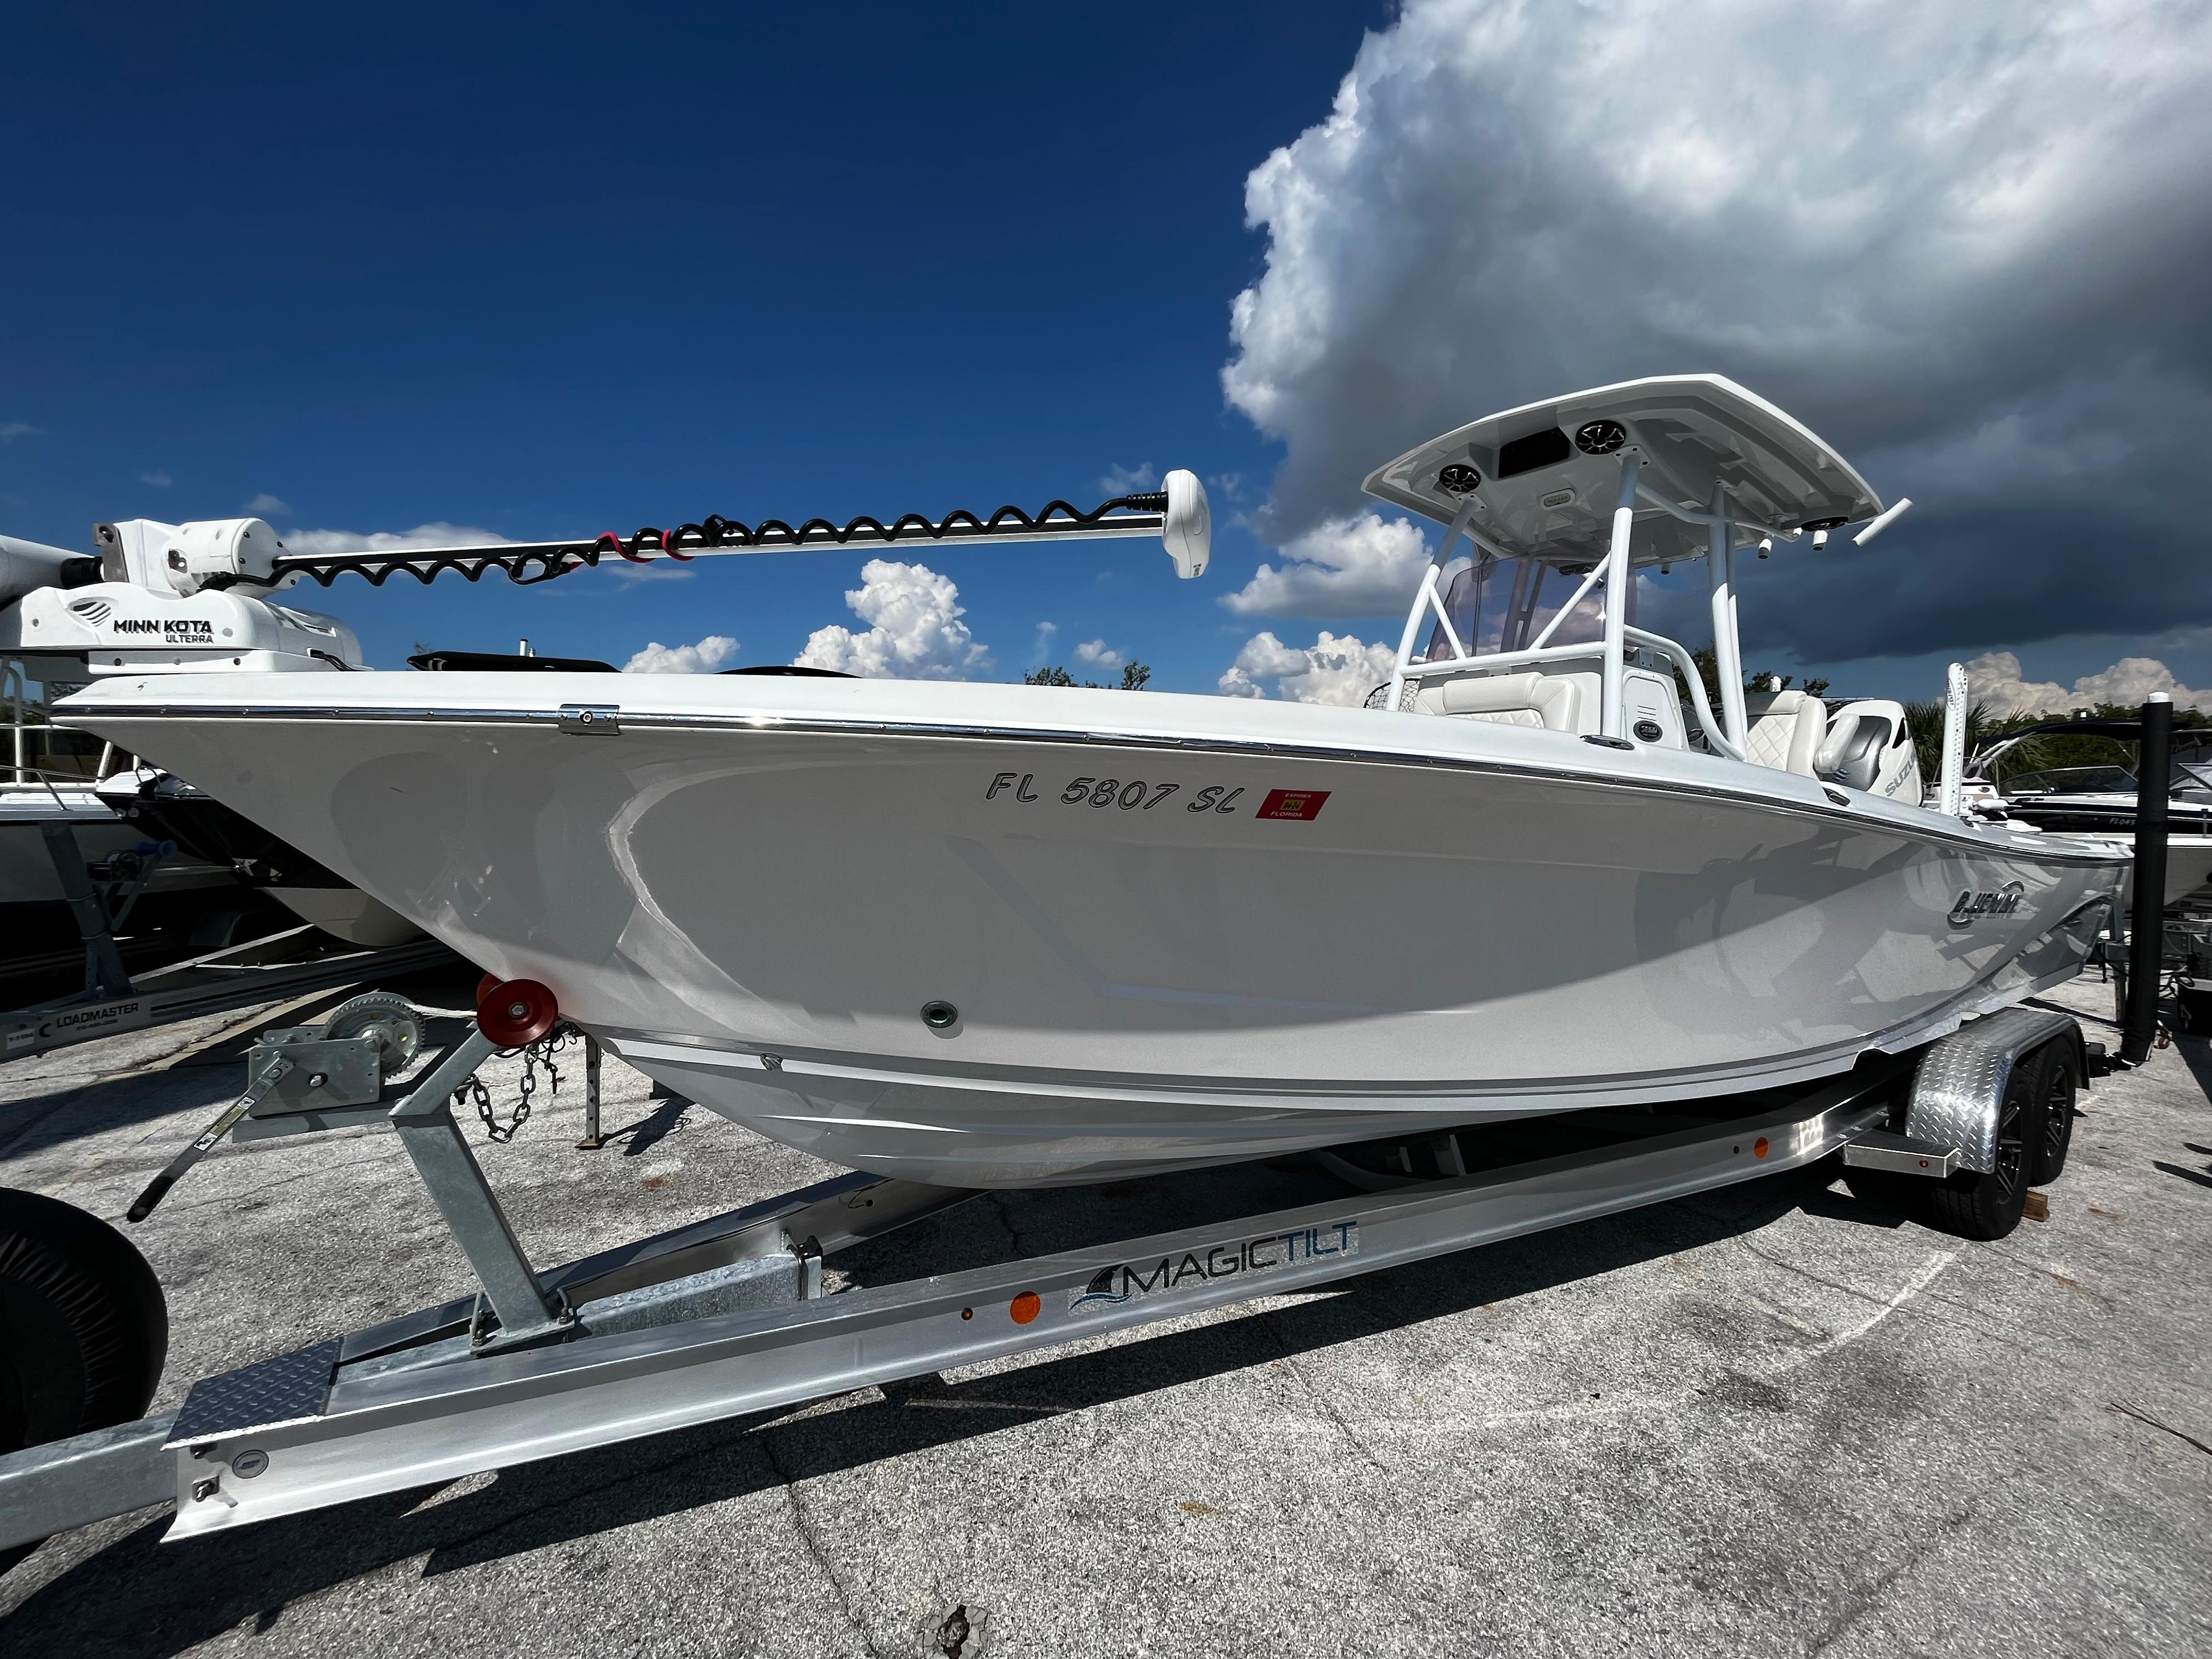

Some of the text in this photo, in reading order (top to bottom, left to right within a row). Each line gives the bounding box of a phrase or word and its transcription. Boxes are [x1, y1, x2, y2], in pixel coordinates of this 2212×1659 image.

[114, 620, 215, 634] MINN KOTA
[166, 635, 215, 644] ULTERRA
[986, 772, 1245, 814] FL 5807 SL
[57, 1003, 139, 1028] LOADMASTER
